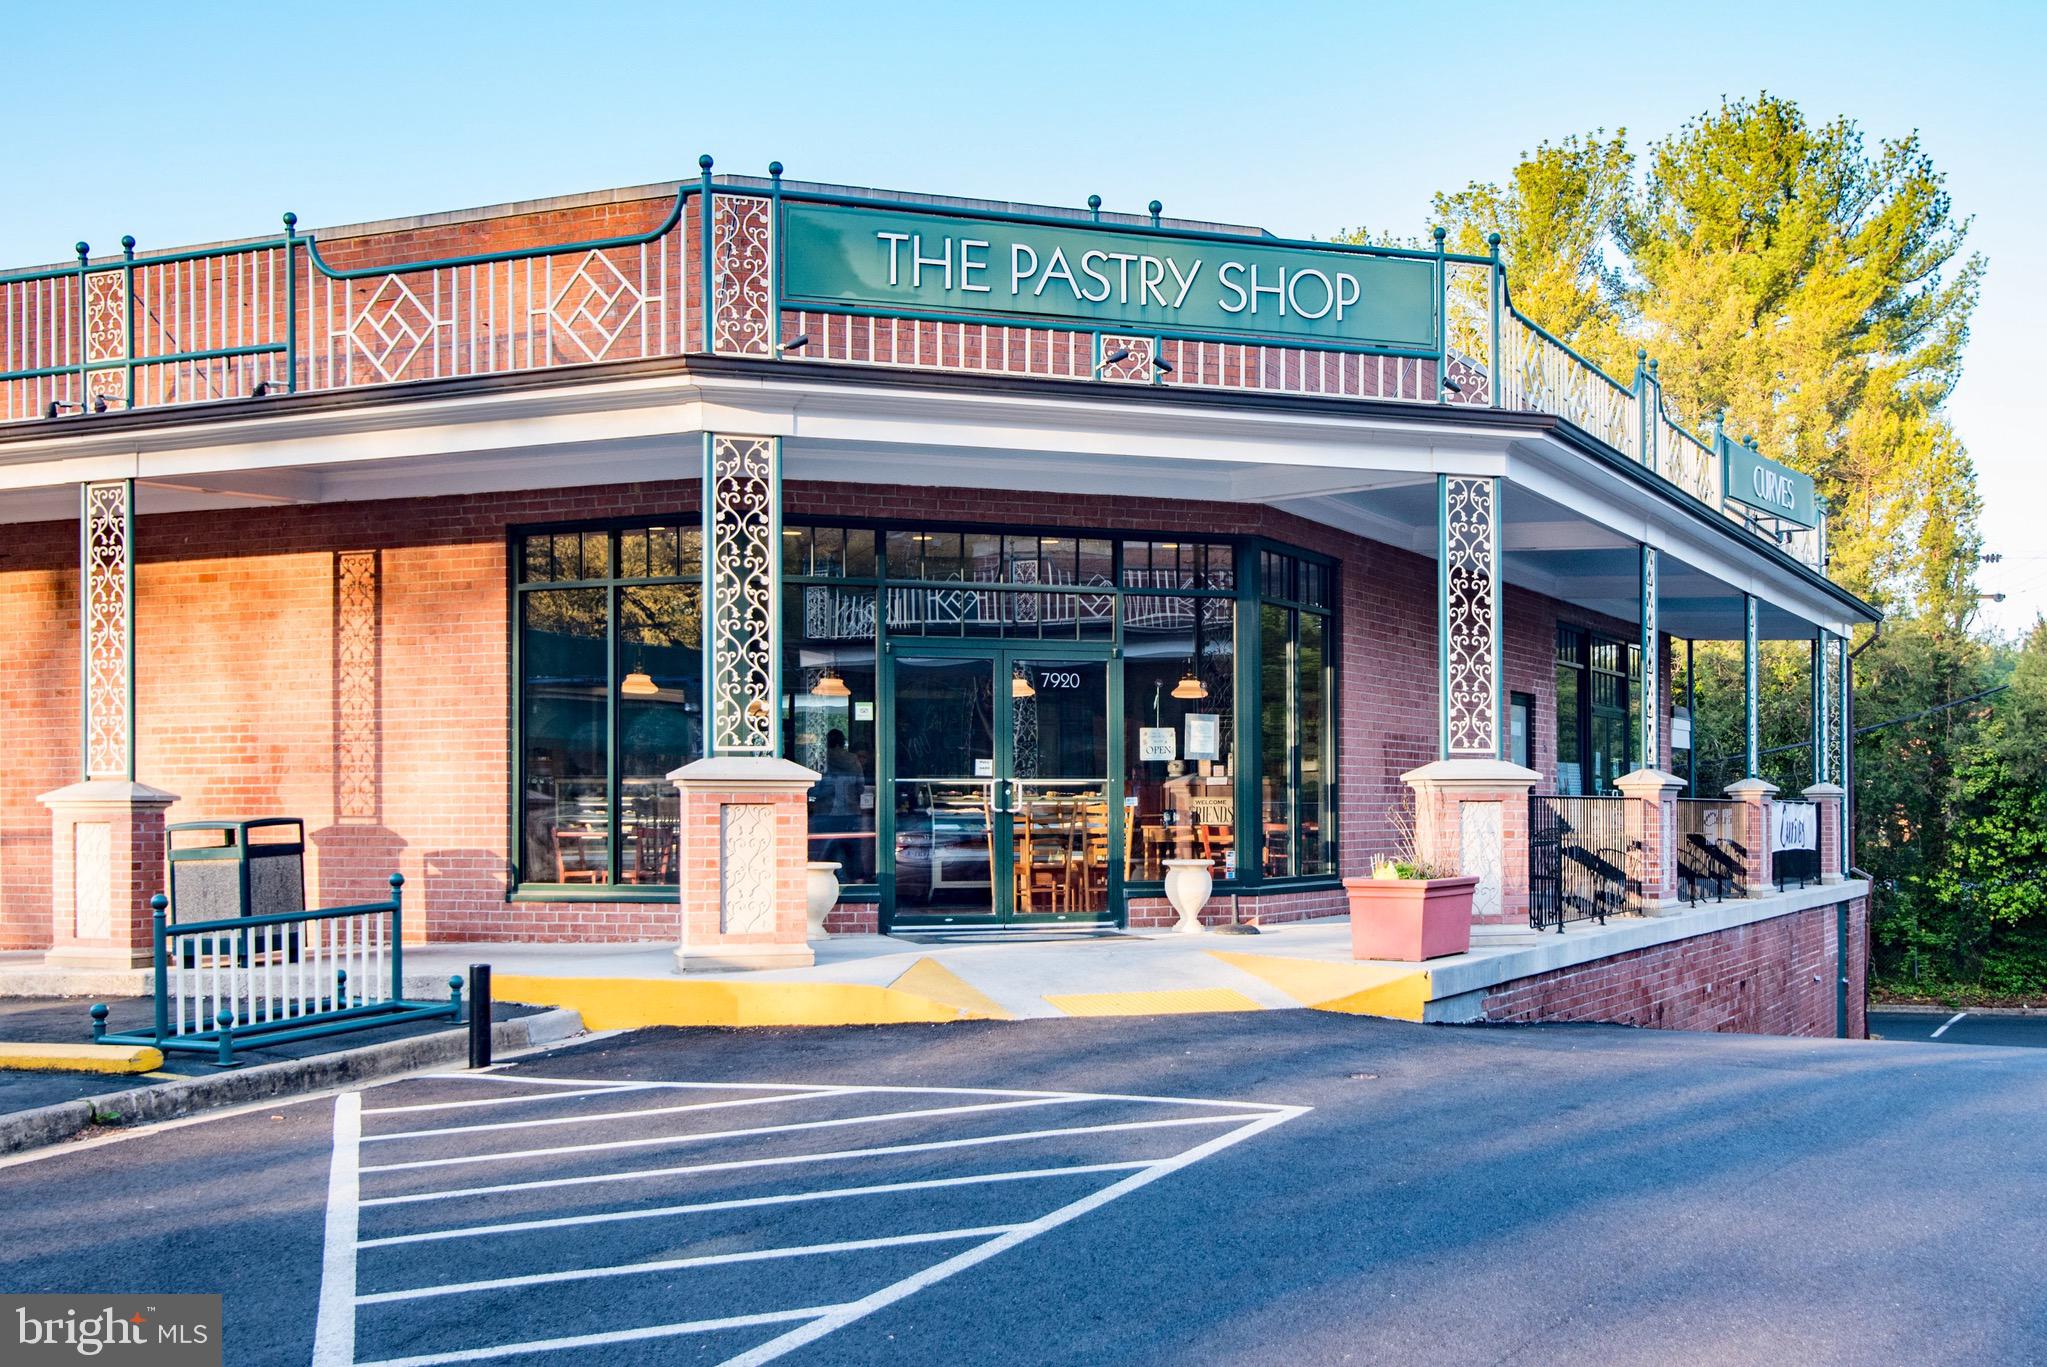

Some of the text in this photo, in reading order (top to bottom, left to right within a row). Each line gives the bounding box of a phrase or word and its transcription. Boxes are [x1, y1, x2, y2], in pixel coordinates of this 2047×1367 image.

[877, 232, 1360, 321] THE PASTRY SHOP
[1754, 466, 1795, 510] CURVES
[1041, 672, 1080, 688] 7920
[1146, 745, 1172, 755] OPEN
[1190, 805, 1234, 823] RIENDS
